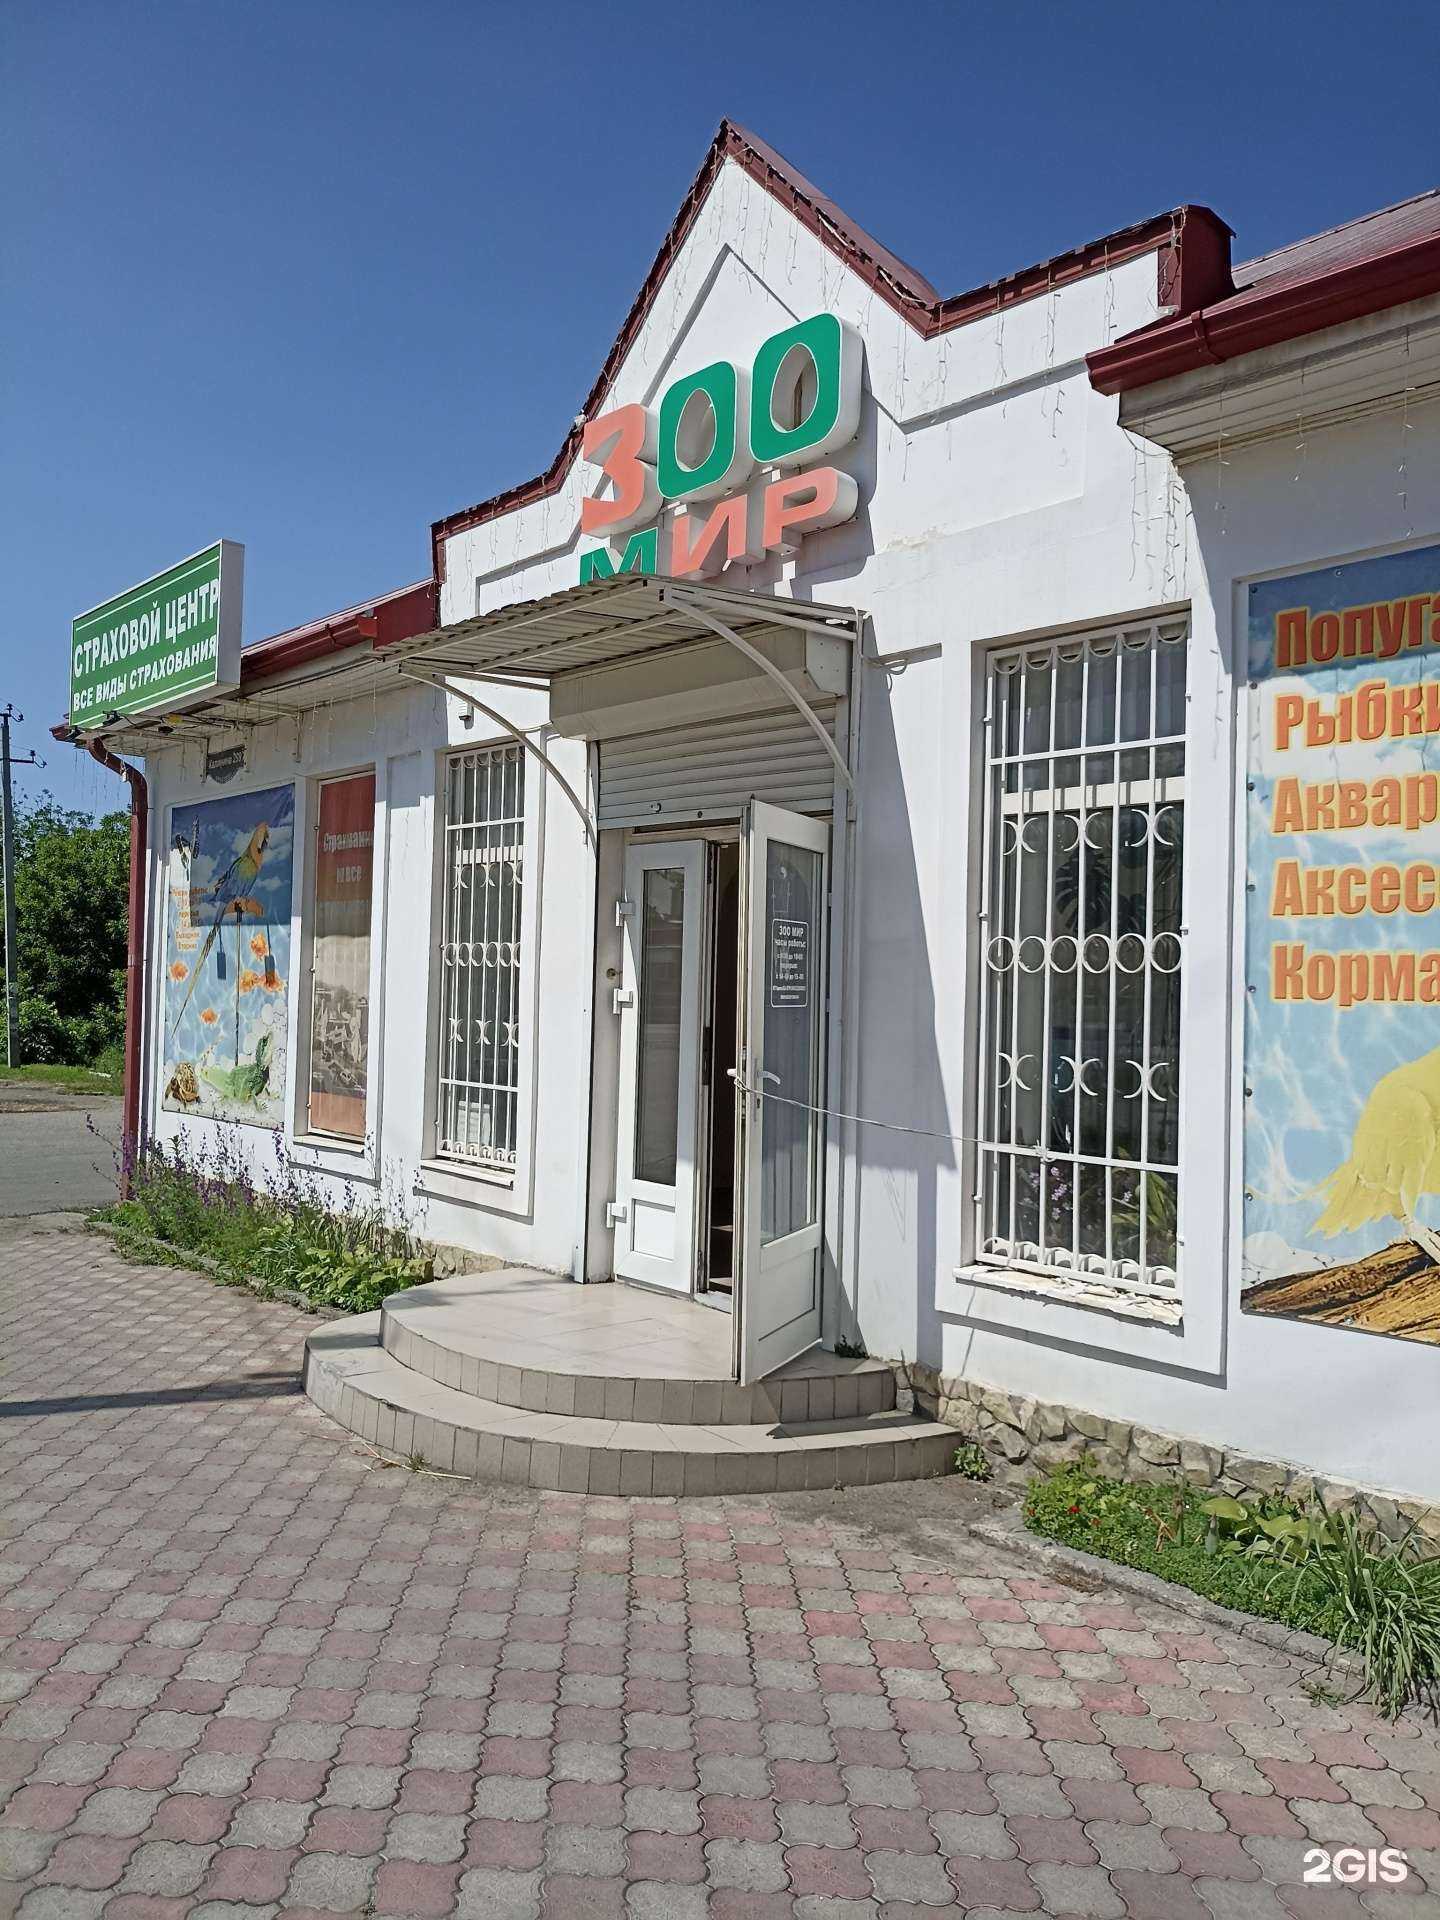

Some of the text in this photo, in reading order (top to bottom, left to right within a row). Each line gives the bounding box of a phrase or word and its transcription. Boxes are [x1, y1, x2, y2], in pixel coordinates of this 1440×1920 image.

[581, 312, 843, 535] ЗОО
[580, 466, 839, 587] МИР
[74, 578, 219, 678] СТРАХОВОЙ ЦЕНТР
[73, 634, 217, 712] ВСЕ ВИДЫ СТРАХОВАНИЯ
[1273, 774, 1438, 833] Аквар
[1272, 861, 1436, 916] Аксес
[779, 925, 804, 938] ЗОО МИР
[1274, 945, 1440, 1007] Корма
